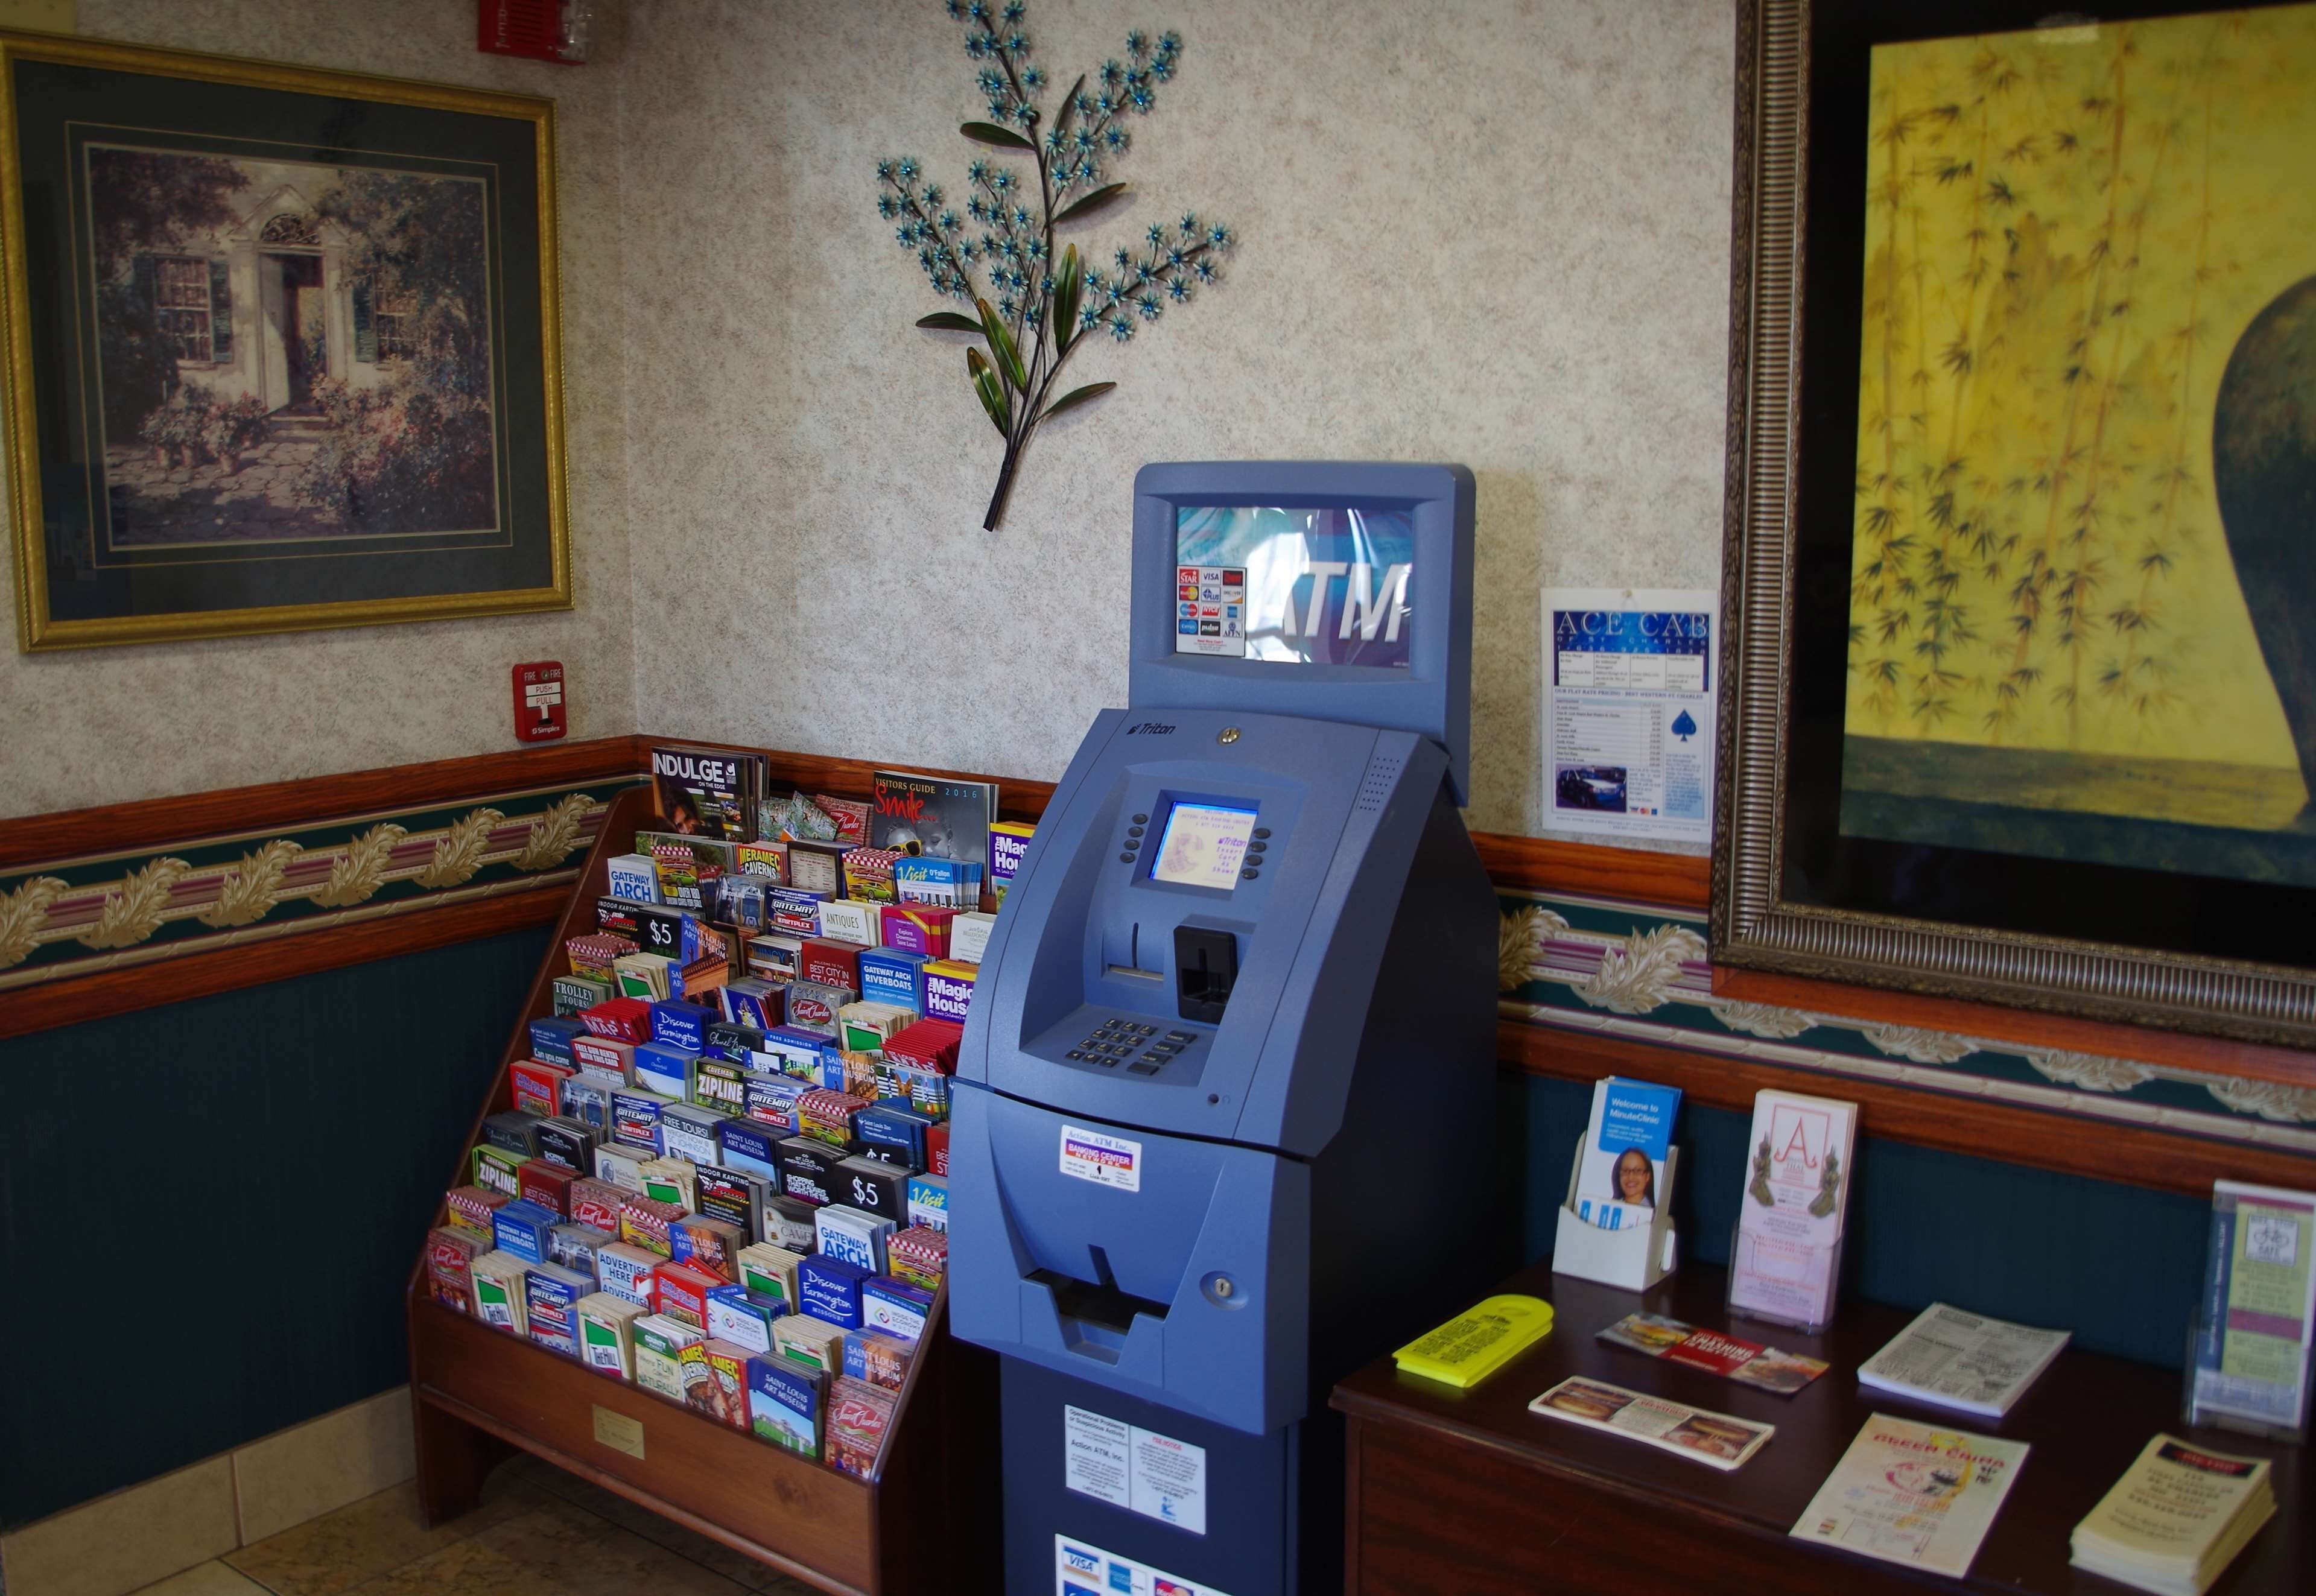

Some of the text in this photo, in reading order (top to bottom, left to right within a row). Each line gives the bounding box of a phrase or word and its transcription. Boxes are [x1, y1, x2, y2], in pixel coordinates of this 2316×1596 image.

[1181, 575, 1197, 583] STAR
[1282, 562, 1411, 642] TM
[1556, 611, 1709, 638] ACE CAB
[524, 671, 536, 681] FIRE
[550, 668, 562, 679] FIRE
[538, 726, 560, 734] Simplex
[1139, 723, 1176, 734] Triton
[652, 752, 725, 784] INDULGE
[875, 777, 907, 790] VISITORS
[909, 783, 935, 794] GUIDE
[739, 848, 781, 872] MERAMEC
[611, 870, 650, 886] GATEWAY
[744, 861, 776, 879] CAVERNS
[897, 865, 928, 884] Visit
[929, 869, 950, 878] O'Fallon
[613, 882, 652, 902] ARCH
[773, 901, 814, 914] GATEWAY
[777, 917, 811, 929] KARTPLEX
[826, 913, 860, 929] ANTIQUES
[650, 919, 672, 945] $5
[684, 920, 726, 951] SAINT LOUIS
[896, 934, 917, 942] Downtown
[898, 928, 913, 937] Explore
[684, 930, 726, 960] ART MUSEUM
[810, 963, 849, 980] BEST CITY IN
[863, 965, 912, 981] GATEWAY ARCH
[554, 981, 594, 1002] TROLLEY
[865, 974, 912, 991] RIVERBOATS
[933, 977, 972, 1001] Magic
[928, 992, 968, 1015] Hous
[585, 1019, 618, 1036] MAP
[659, 1012, 695, 1030] Discover
[657, 1024, 699, 1045] Farmington
[784, 1037, 813, 1048] ADMISSION
[534, 1048, 570, 1066] Can you come
[826, 1055, 875, 1074] SAINT LOUIS
[706, 1065, 734, 1078] CAVEMAN
[826, 1065, 875, 1085] ART MUSEUM
[697, 1075, 743, 1104] ZIPLINE
[749, 1093, 793, 1109] GATEWAY
[1611, 1097, 1659, 1113] Welcome to
[617, 1107, 655, 1123] GATEWAY
[1609, 1107, 1660, 1126] MinuteClinic
[664, 1115, 709, 1139] FREE TOURS!
[677, 1137, 711, 1156] JOHNSON
[686, 1134, 701, 1144] NOW
[726, 1130, 764, 1150] SAINT LOUIS
[728, 1139, 765, 1157] ART MUSEUM
[1068, 1130, 1112, 1147] Action ATM
[1773, 1115, 1818, 1170] A
[1068, 1143, 1130, 1165] BANKING CENTER
[1076, 1151, 1120, 1168] NETWORK
[480, 1164, 518, 1195] ZIPLINE
[697, 1166, 749, 1186] INDOOR KARTING
[525, 1187, 538, 1198] BEST
[539, 1191, 551, 1203] CITY
[852, 1176, 878, 1205] $5
[912, 1186, 946, 1208] Visit
[497, 1222, 534, 1241] GATEWAY ARCH
[498, 1230, 536, 1251] RIVERBOATS
[675, 1231, 722, 1251] SAINT LOUIS
[781, 1226, 813, 1243] CAVE
[820, 1226, 868, 1252] GATEWAY
[677, 1241, 723, 1261] ART MUSEUM
[824, 1240, 870, 1270] ARCH
[599, 1253, 647, 1278] ADVERTISE
[609, 1267, 631, 1284] HERE
[806, 1268, 848, 1293] Discover
[530, 1287, 568, 1303] GATEWAY
[603, 1283, 648, 1308] ADVERTISE
[803, 1282, 852, 1309] Farmington
[1689, 1334, 1755, 1358] SMASHING
[848, 1344, 901, 1371] SAINT LOUIS
[847, 1357, 901, 1382] ART MUSEUM
[764, 1373, 808, 1404] SAINT LOUIS
[764, 1382, 807, 1413] ART MUSEUM
[1872, 1432, 2006, 1468] GREEN CHINA
[1069, 1554, 1094, 1572] VISA
